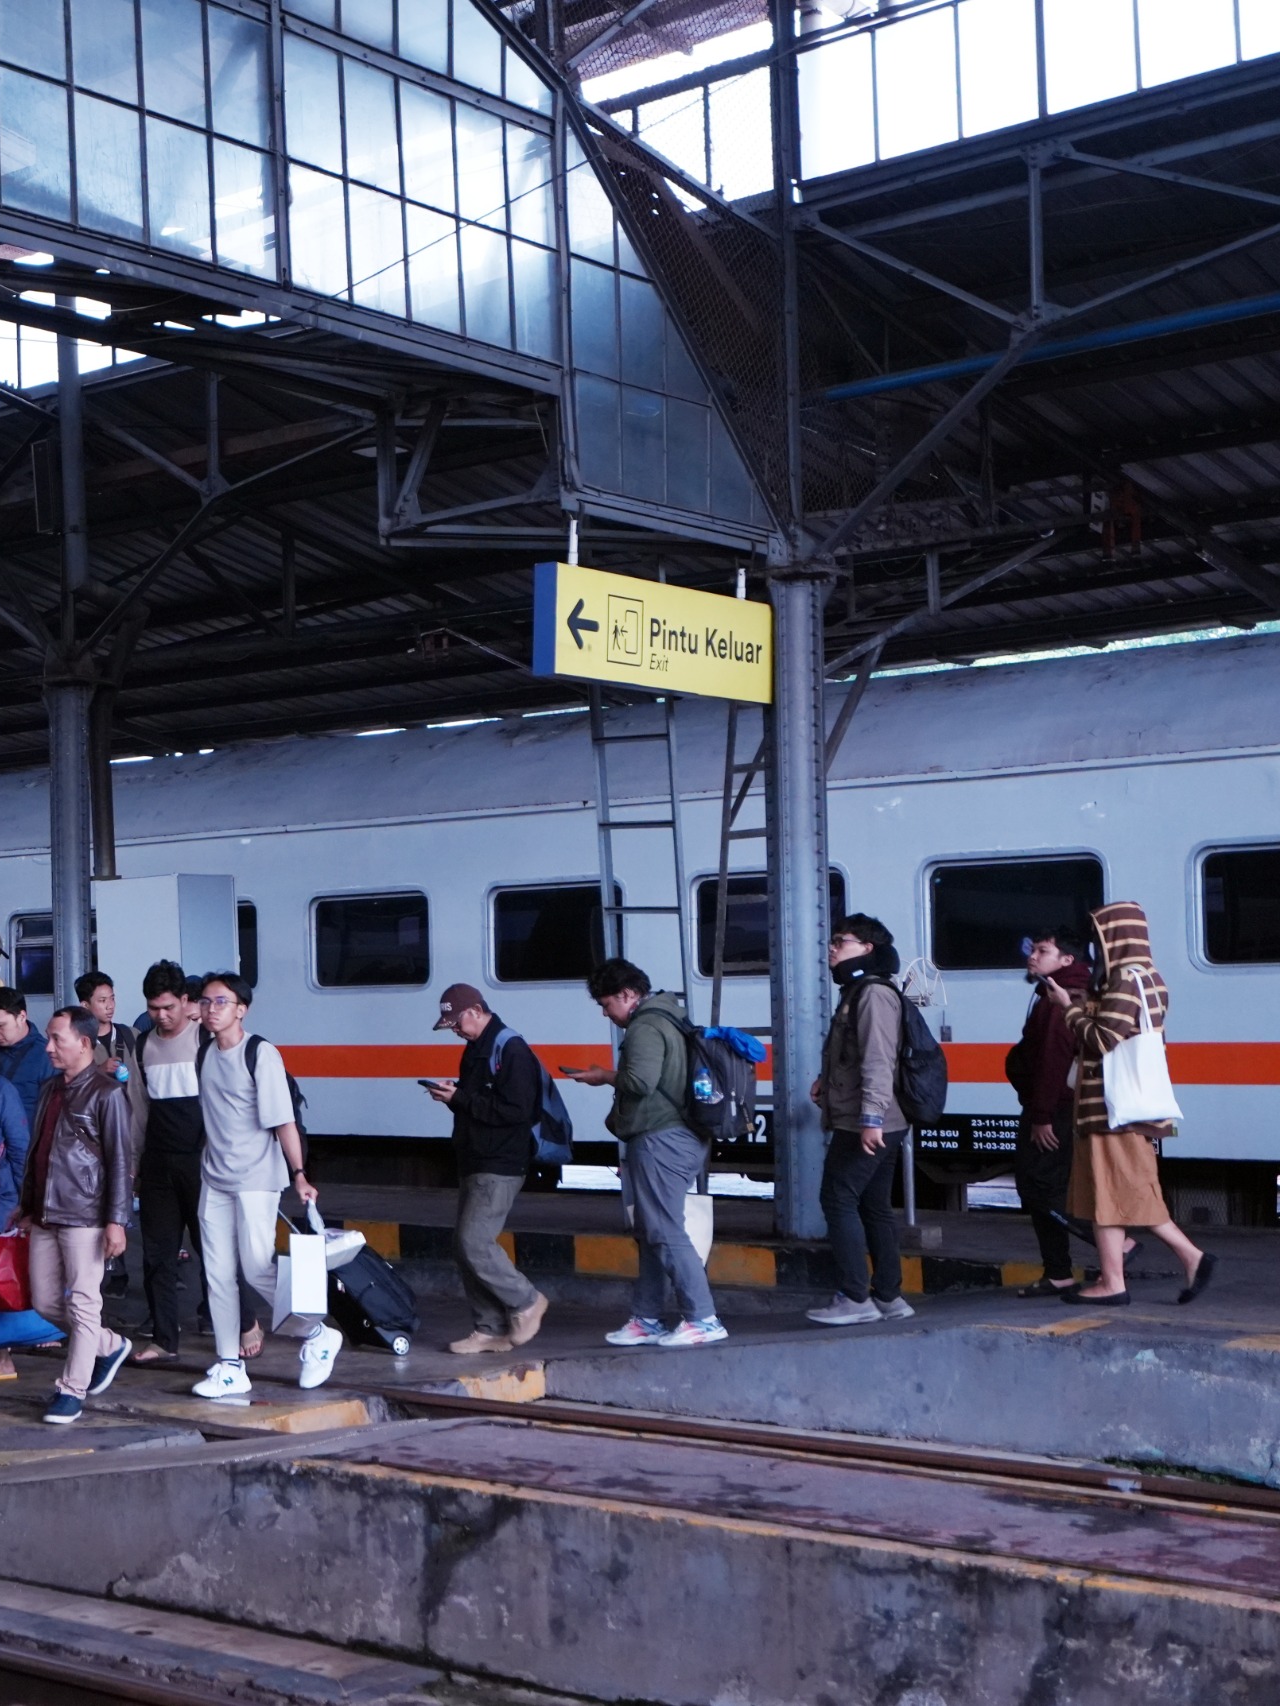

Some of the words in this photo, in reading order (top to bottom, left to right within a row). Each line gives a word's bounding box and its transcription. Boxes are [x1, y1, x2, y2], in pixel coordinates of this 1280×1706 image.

[650, 618, 698, 654] Pintu
[705, 627, 762, 664] Keluar
[649, 653, 669, 672] Exit
[921, 1129, 938, 1137] P24
[921, 1140, 938, 1148] P48
[940, 1141, 958, 1149] YAD
